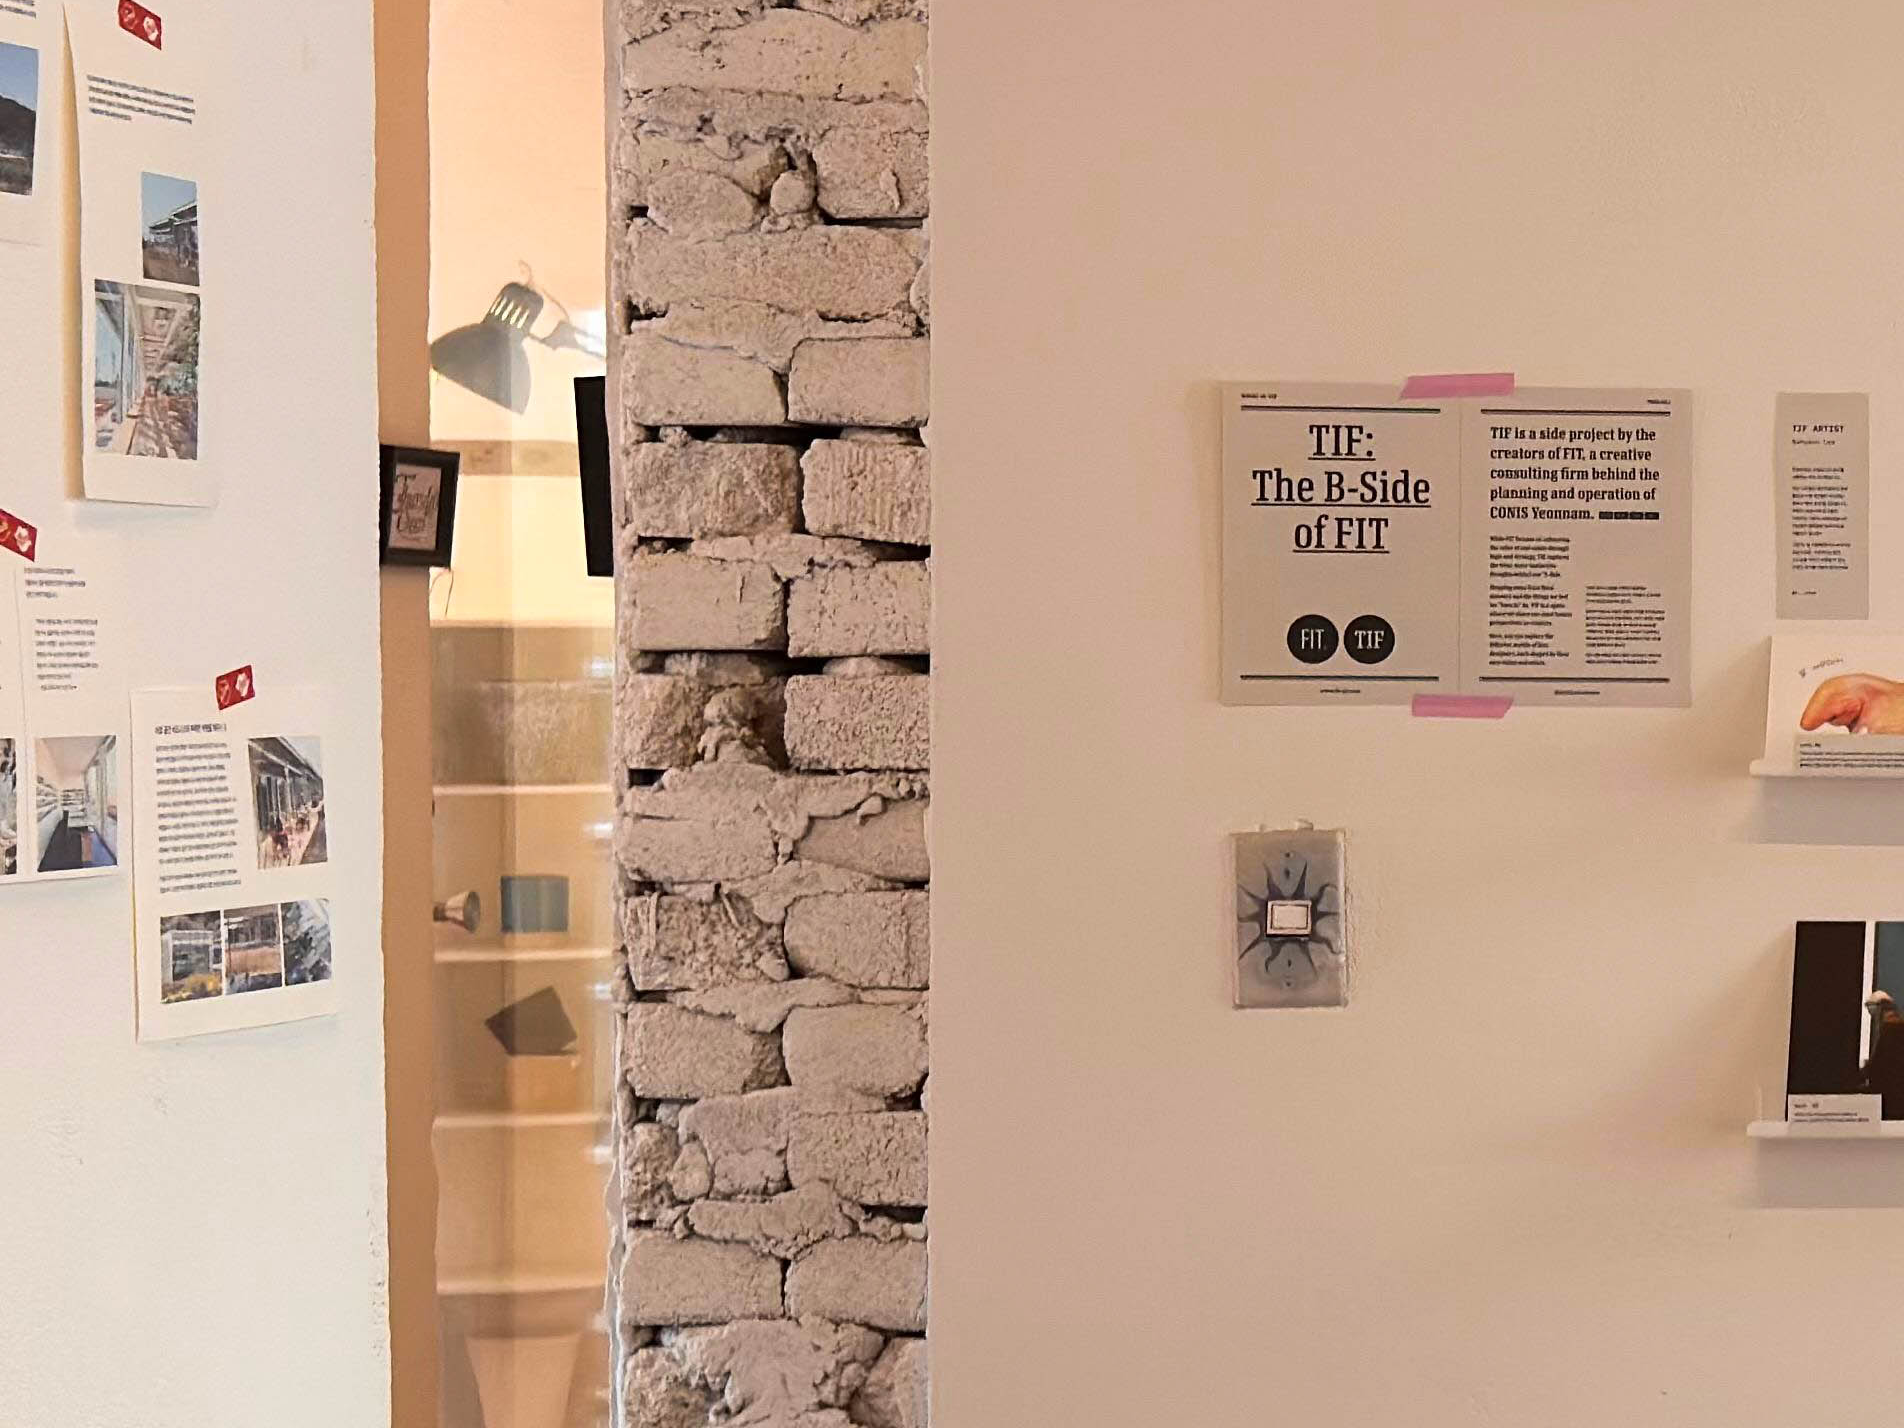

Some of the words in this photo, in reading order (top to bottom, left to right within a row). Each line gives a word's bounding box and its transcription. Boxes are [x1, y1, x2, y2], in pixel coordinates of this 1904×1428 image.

[1309, 425, 1374, 457] TIF:
[1490, 426, 1512, 439] TIF
[1514, 427, 1526, 439] is
[1528, 430, 1537, 440] a
[1539, 427, 1566, 440] side
[1569, 428, 1614, 442] project
[1618, 428, 1633, 443] by
[1635, 428, 1656, 441] the
[1490, 448, 1545, 460] creators
[1548, 446, 1562, 460] of
[1589, 450, 1597, 460] a
[1599, 448, 1652, 460] creative
[1490, 466, 1559, 482] consulting
[1560, 467, 1589, 480] firm
[1592, 467, 1636, 480] behind
[1639, 468, 1660, 480] the
[1252, 468, 1314, 502] The
[1324, 470, 1430, 503] B-Side
[1490, 486, 1549, 502] planning
[1550, 487, 1575, 500] and
[1578, 487, 1640, 502] operation
[1643, 487, 1657, 500] of
[1490, 506, 1529, 519] CONIS
[1532, 506, 1595, 520] Yeonnam.
[1294, 514, 1329, 548] of
[1334, 518, 1389, 550] FIT
[1354, 630, 1385, 650] TIF
